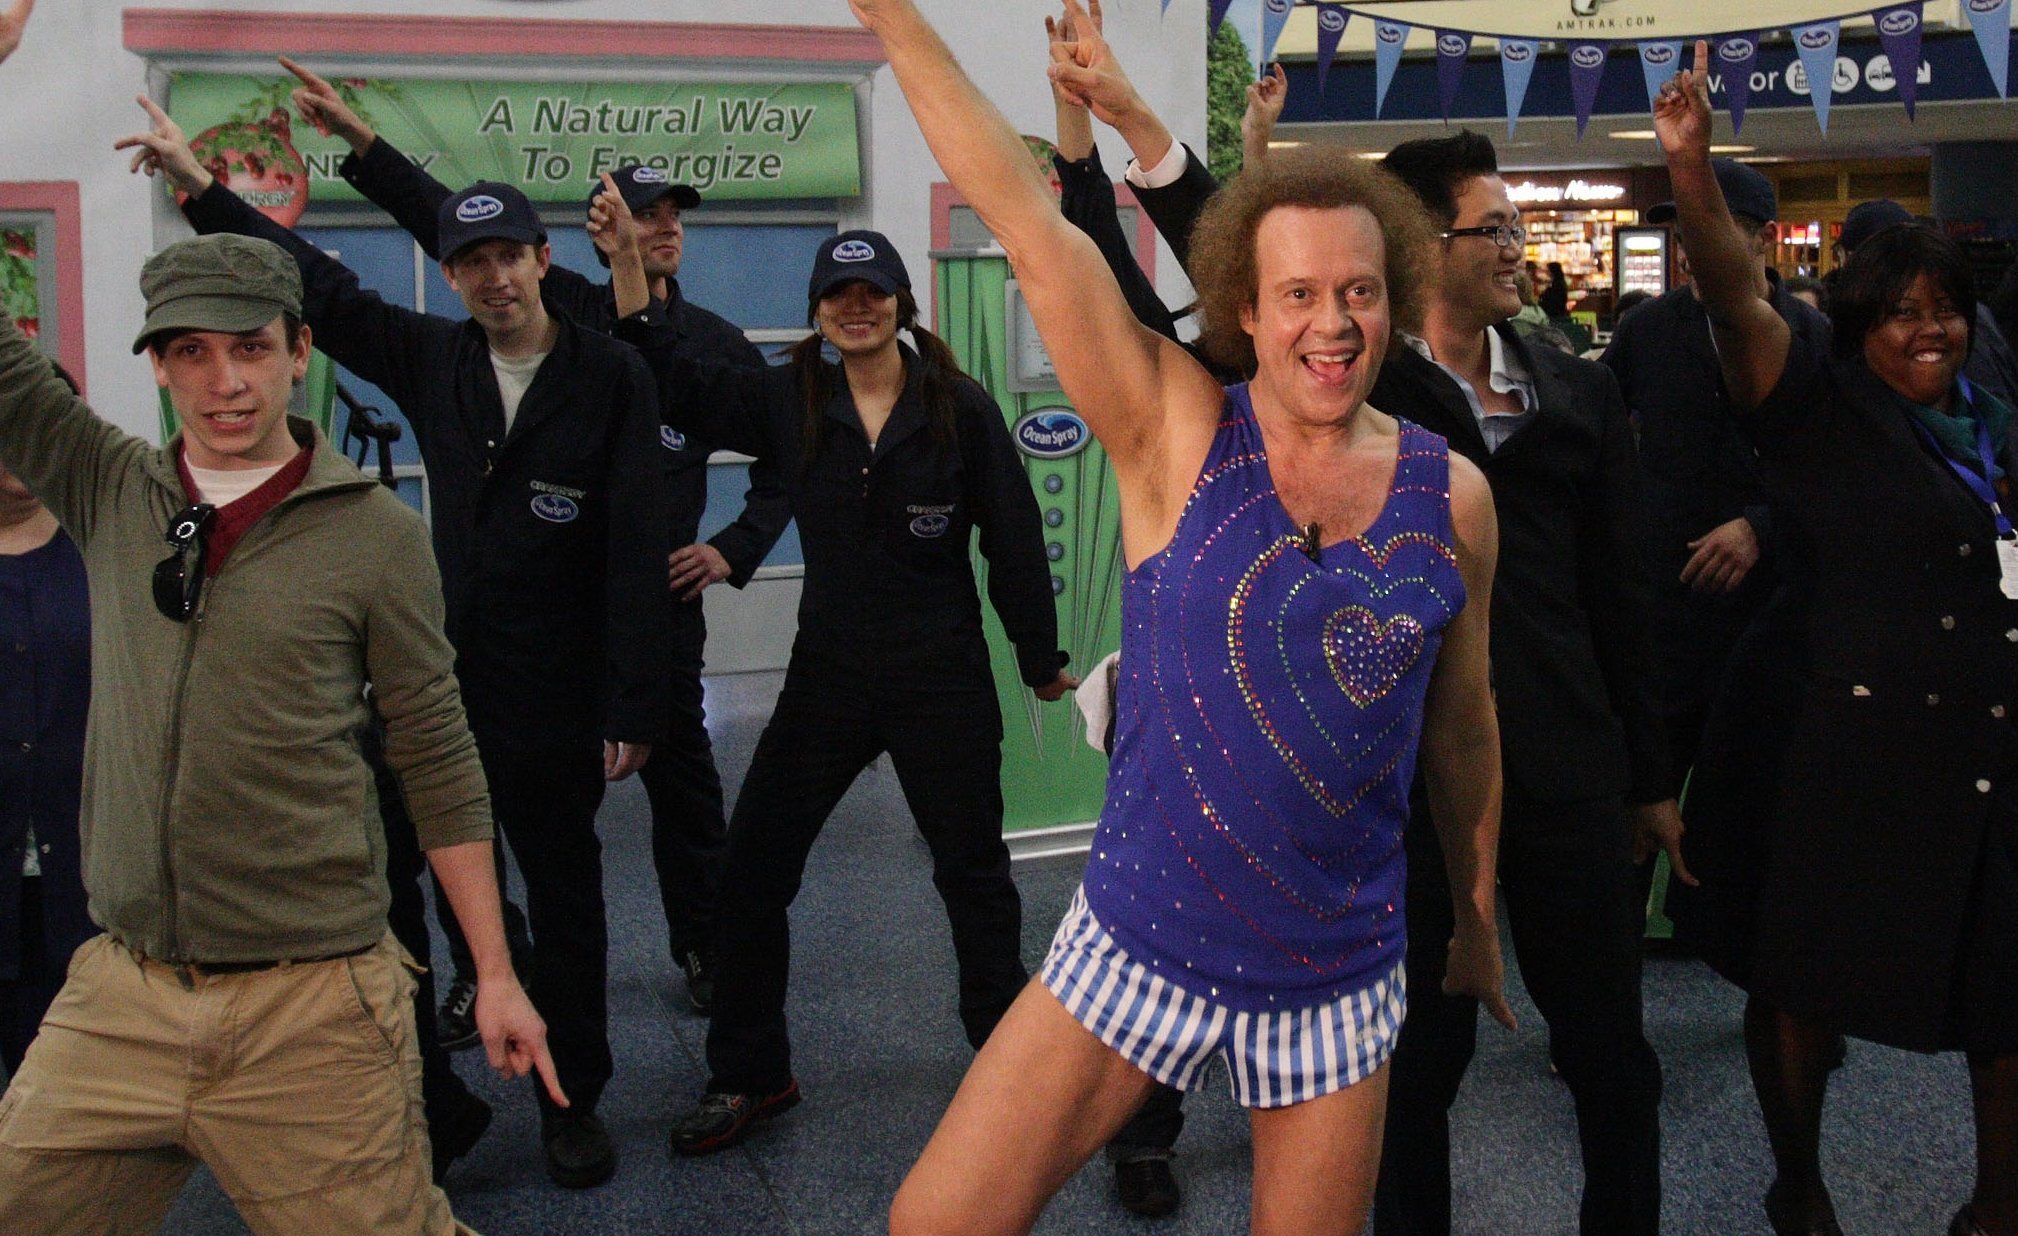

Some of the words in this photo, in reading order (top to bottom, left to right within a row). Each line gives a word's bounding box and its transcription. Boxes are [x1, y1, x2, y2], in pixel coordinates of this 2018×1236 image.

[1556, 16, 1655, 31] AMTRAK.COM
[480, 97, 515, 134] A
[532, 97, 702, 135] Natural
[719, 97, 816, 142] Way
[521, 146, 571, 182] To
[1023, 425, 1052, 445] Ocean
[1051, 426, 1078, 447] Spray
